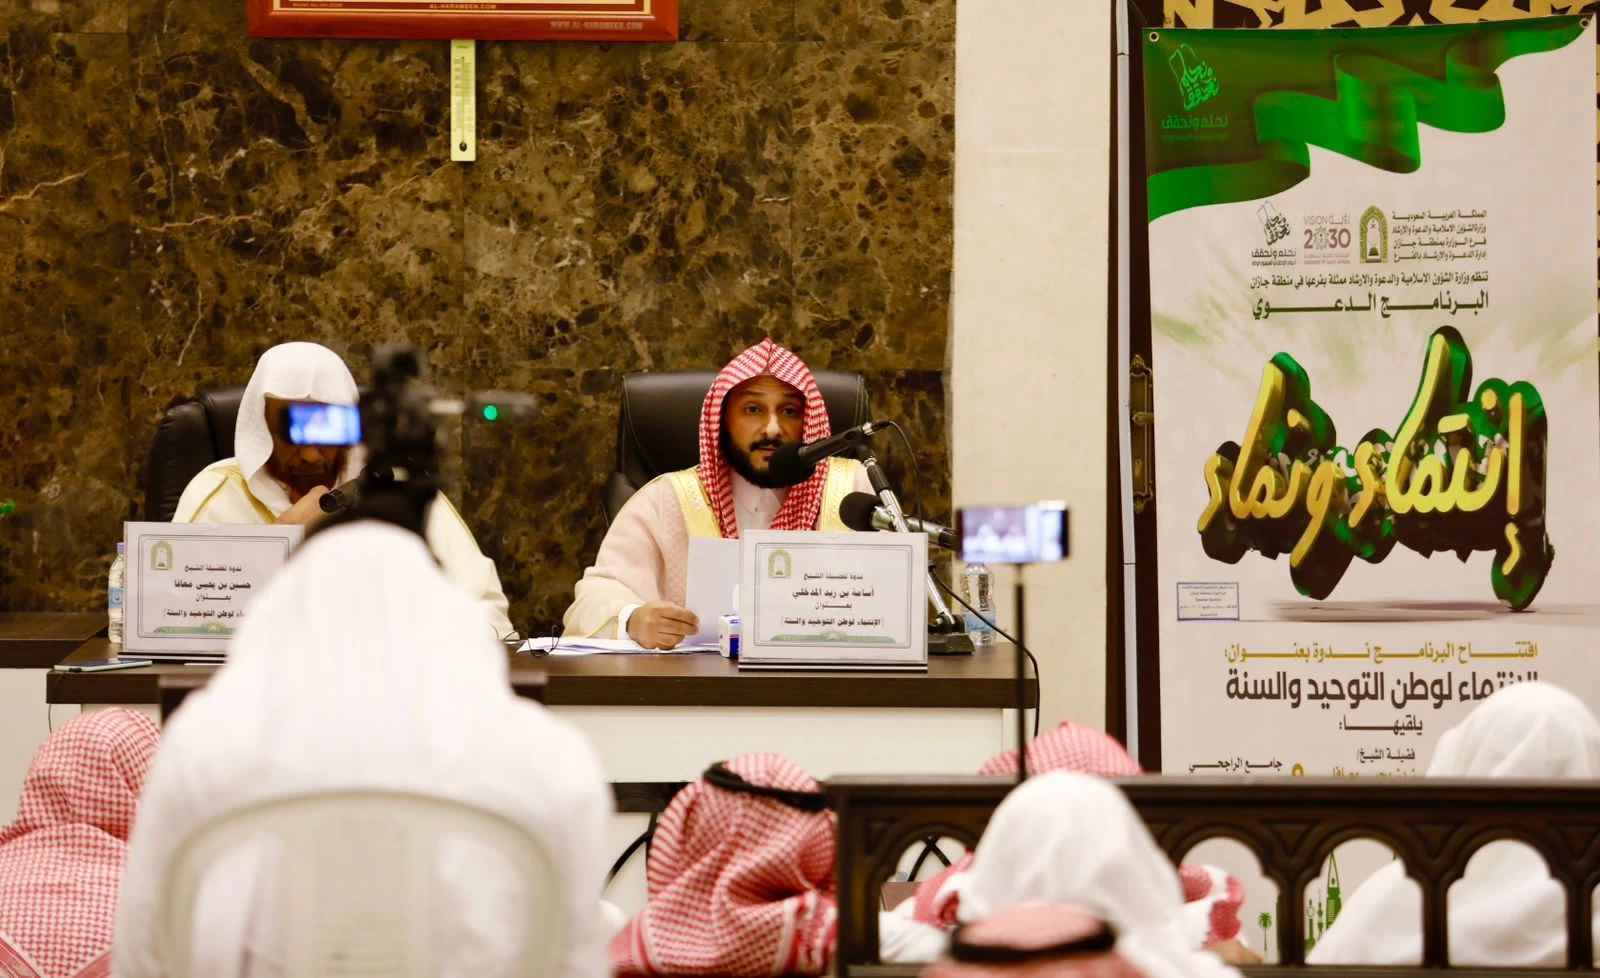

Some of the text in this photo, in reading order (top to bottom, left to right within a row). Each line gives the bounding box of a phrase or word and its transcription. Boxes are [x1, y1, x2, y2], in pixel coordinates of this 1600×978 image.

[1252, 288, 1489, 320] البرنامج الدعوي
[1312, 641, 1371, 664] ندوة
[1373, 641, 1455, 665] البرنامج
[1457, 640, 1538, 665] افتتاح
[1226, 668, 1302, 710] والسنة
[1307, 671, 1385, 710] التوحيد
[1390, 671, 1453, 710] لوطن
[1338, 713, 1423, 736] يلقيها:
[1188, 756, 1283, 775] جامع الراجحي
[1386, 747, 1415, 763] فضيلة
